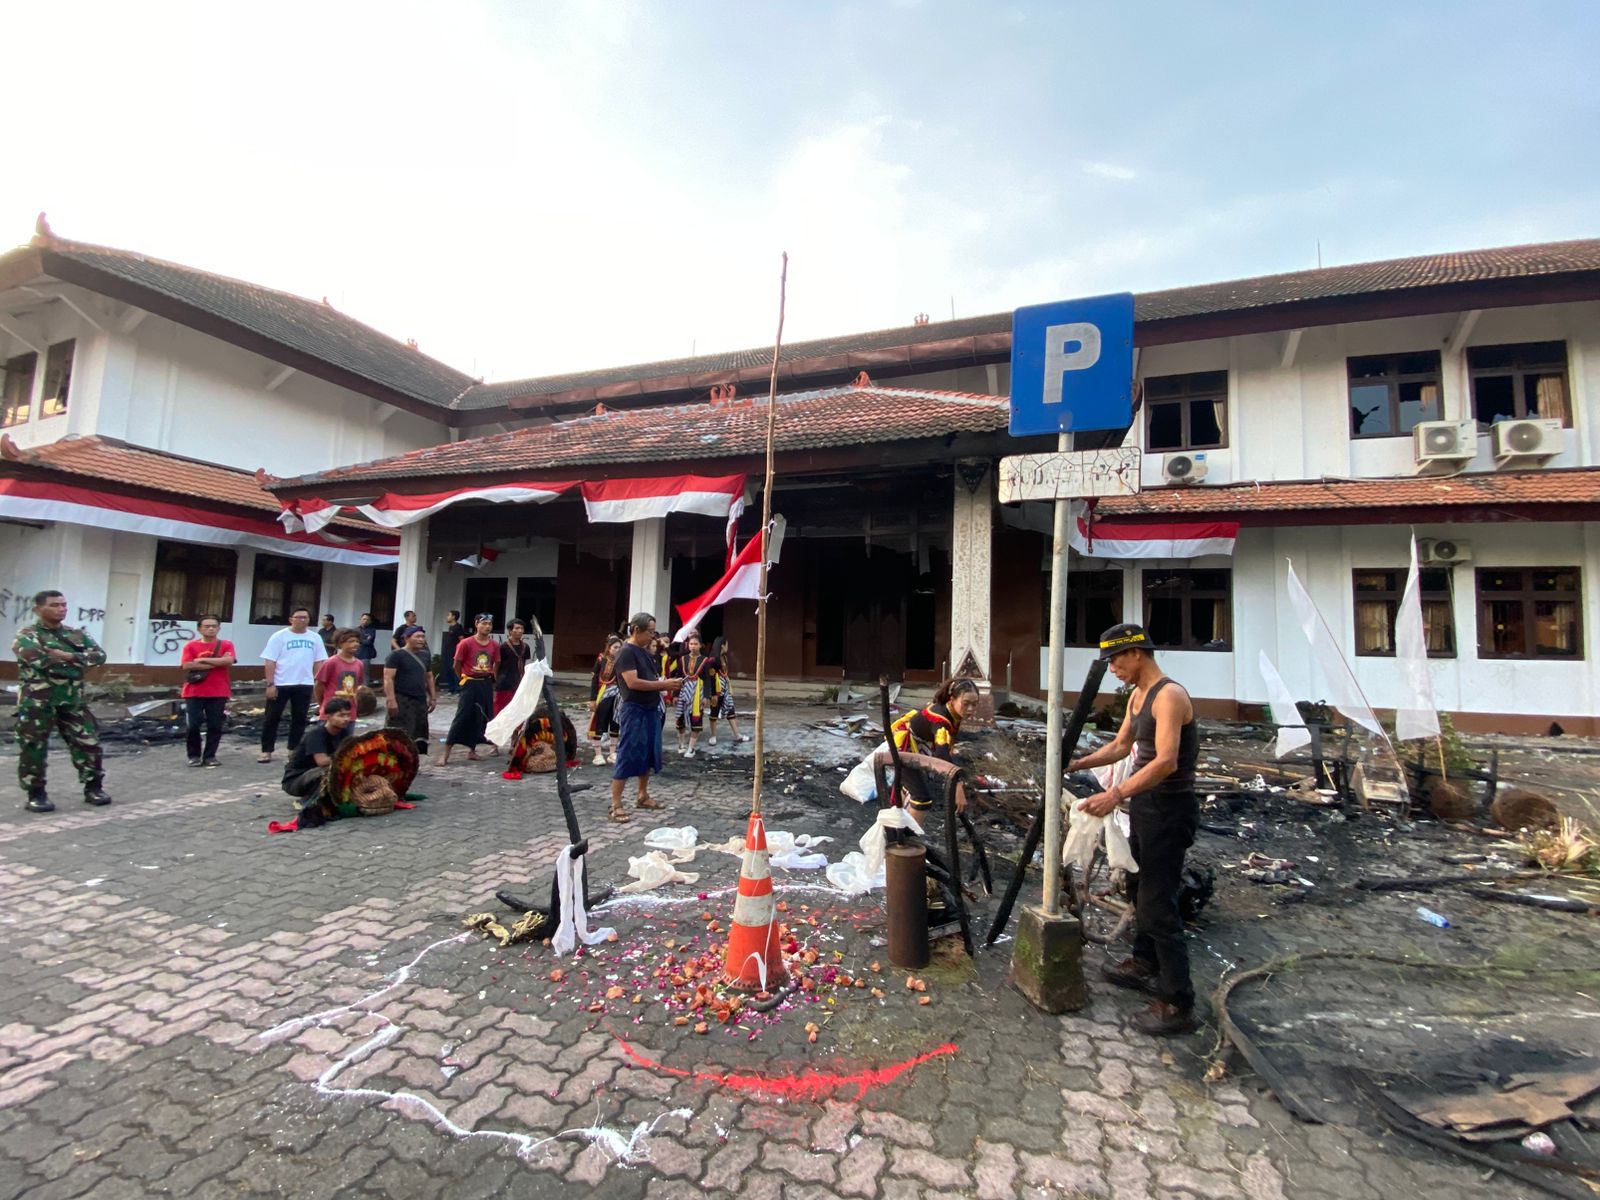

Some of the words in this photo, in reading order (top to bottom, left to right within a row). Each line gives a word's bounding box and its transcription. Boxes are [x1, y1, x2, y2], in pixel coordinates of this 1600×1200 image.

[1042, 322, 1101, 404] P
[78, 607, 105, 622] DPR
[152, 620, 181, 633] DPR
